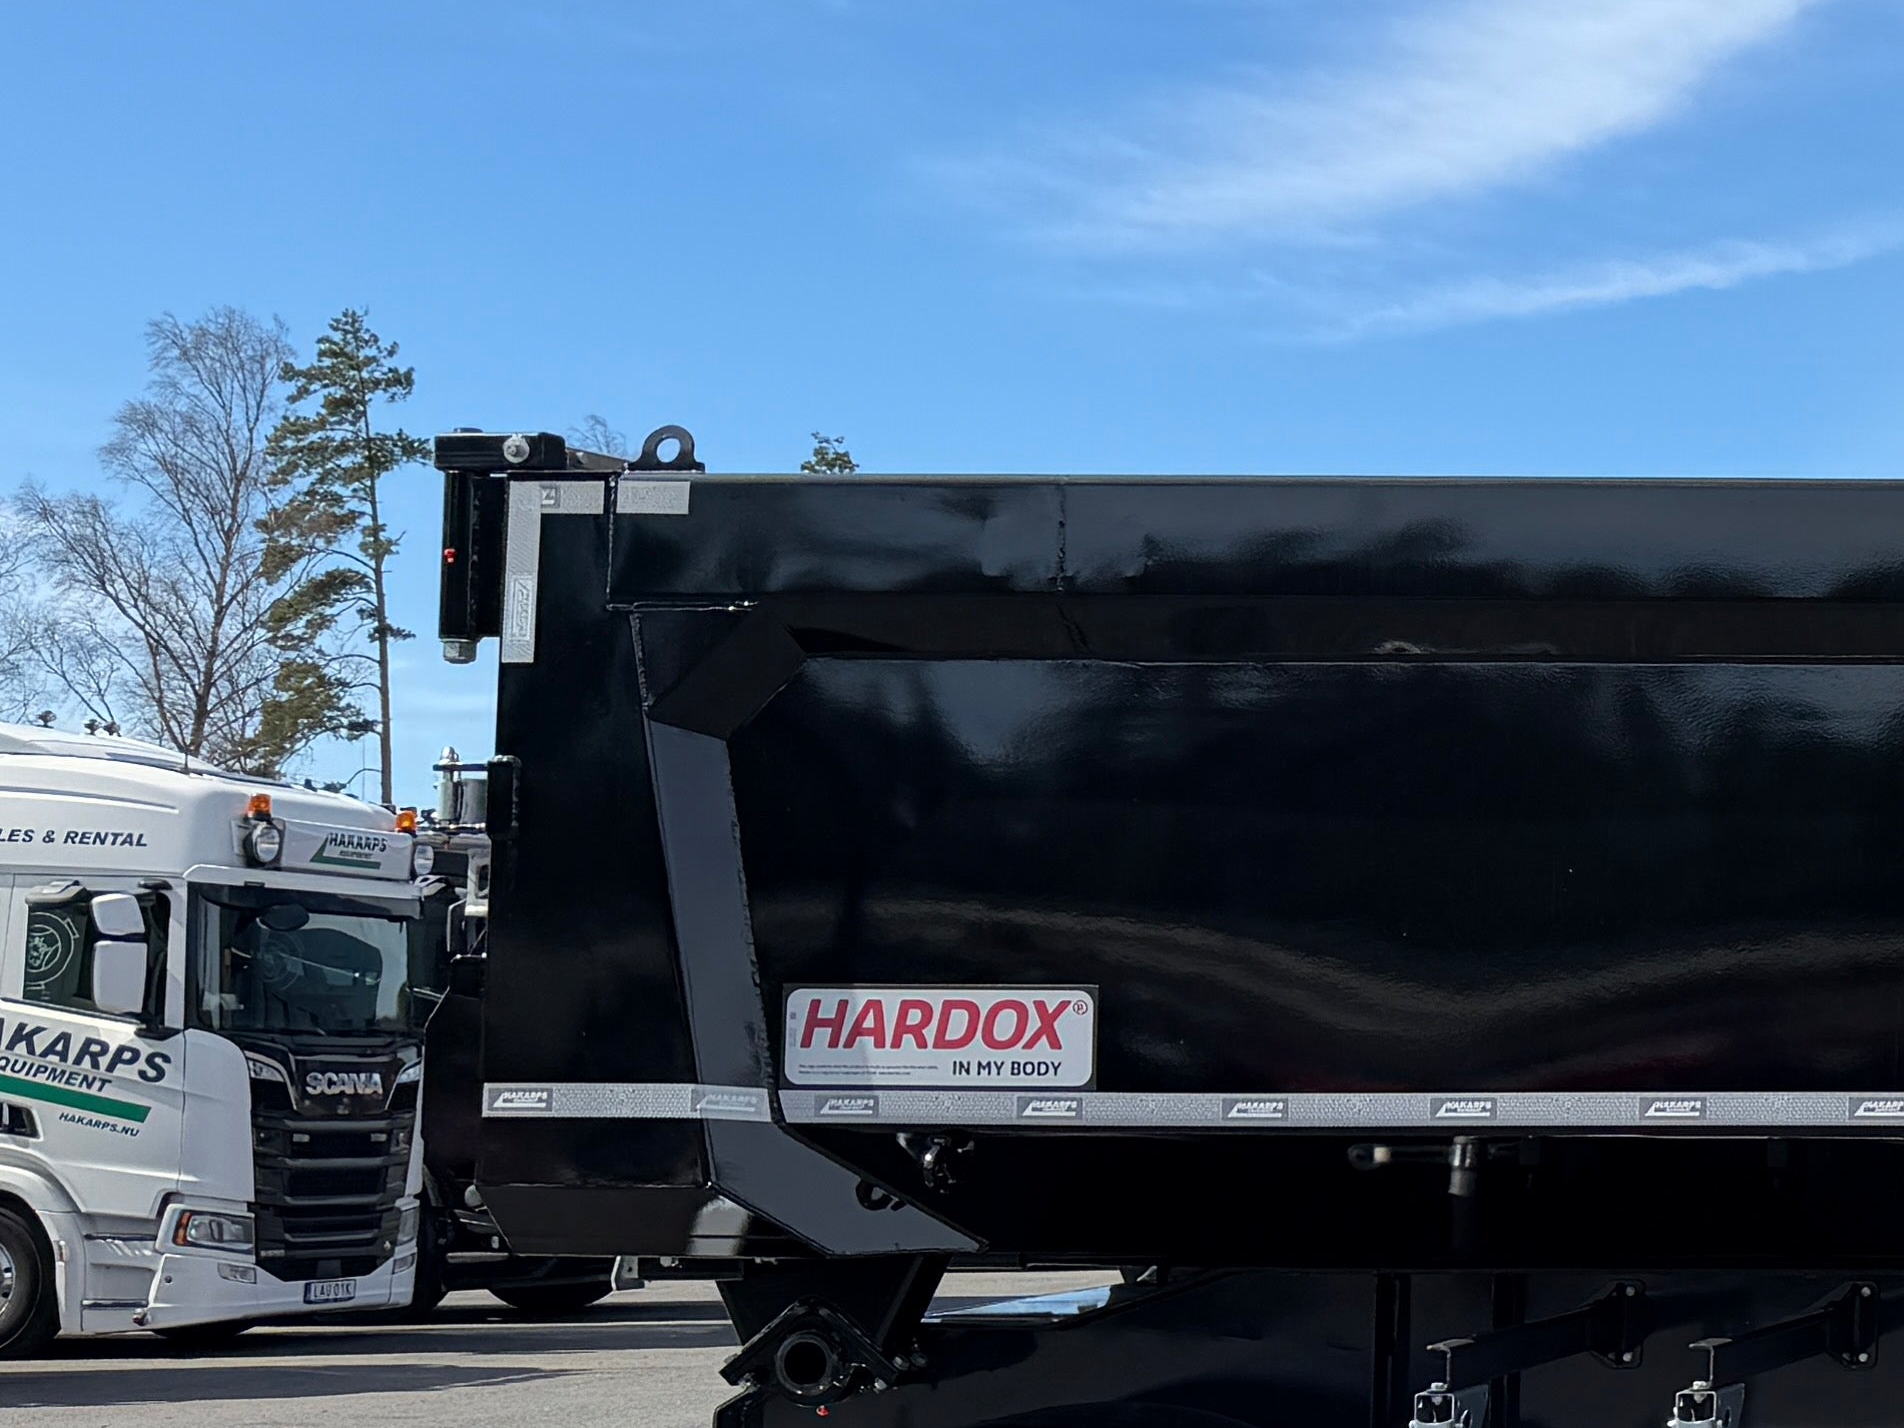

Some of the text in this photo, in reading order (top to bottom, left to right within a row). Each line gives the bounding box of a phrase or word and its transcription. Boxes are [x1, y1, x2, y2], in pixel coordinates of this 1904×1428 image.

[42, 830, 55, 843] &
[63, 831, 148, 847] RENTAL
[0, 1018, 172, 1083] KARPS
[952, 1060, 970, 1076] IN
[977, 1061, 1004, 1076] MY
[1010, 1061, 1062, 1077] BODY
[305, 1072, 383, 1095] SCANIA
[59, 1112, 140, 1137] HAKARPS.NU
